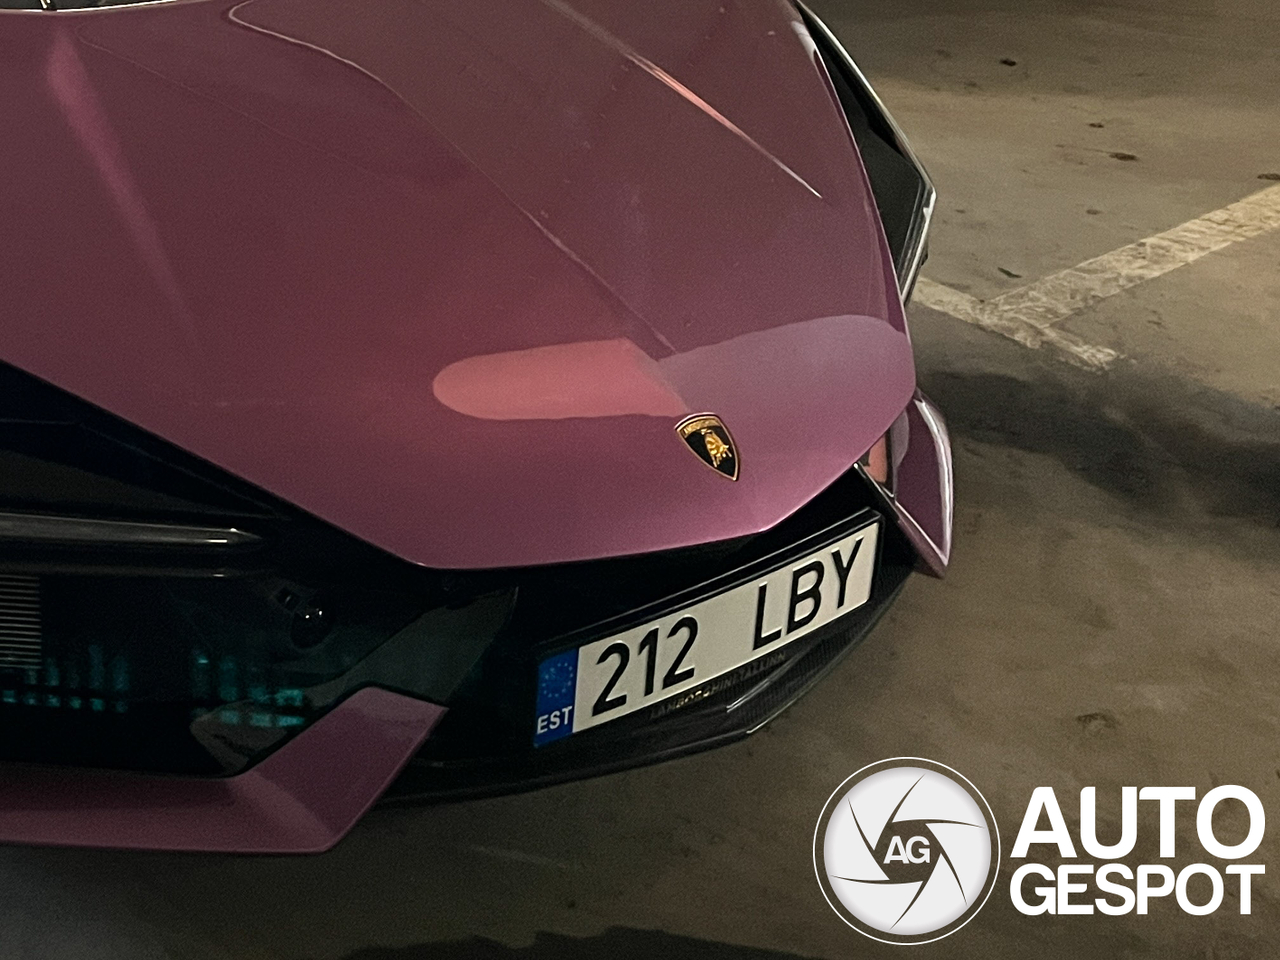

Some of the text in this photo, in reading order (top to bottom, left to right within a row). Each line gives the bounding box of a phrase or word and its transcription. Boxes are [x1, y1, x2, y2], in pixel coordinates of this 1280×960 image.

[592, 535, 865, 717] 212 LBY
[536, 706, 573, 736] EST
